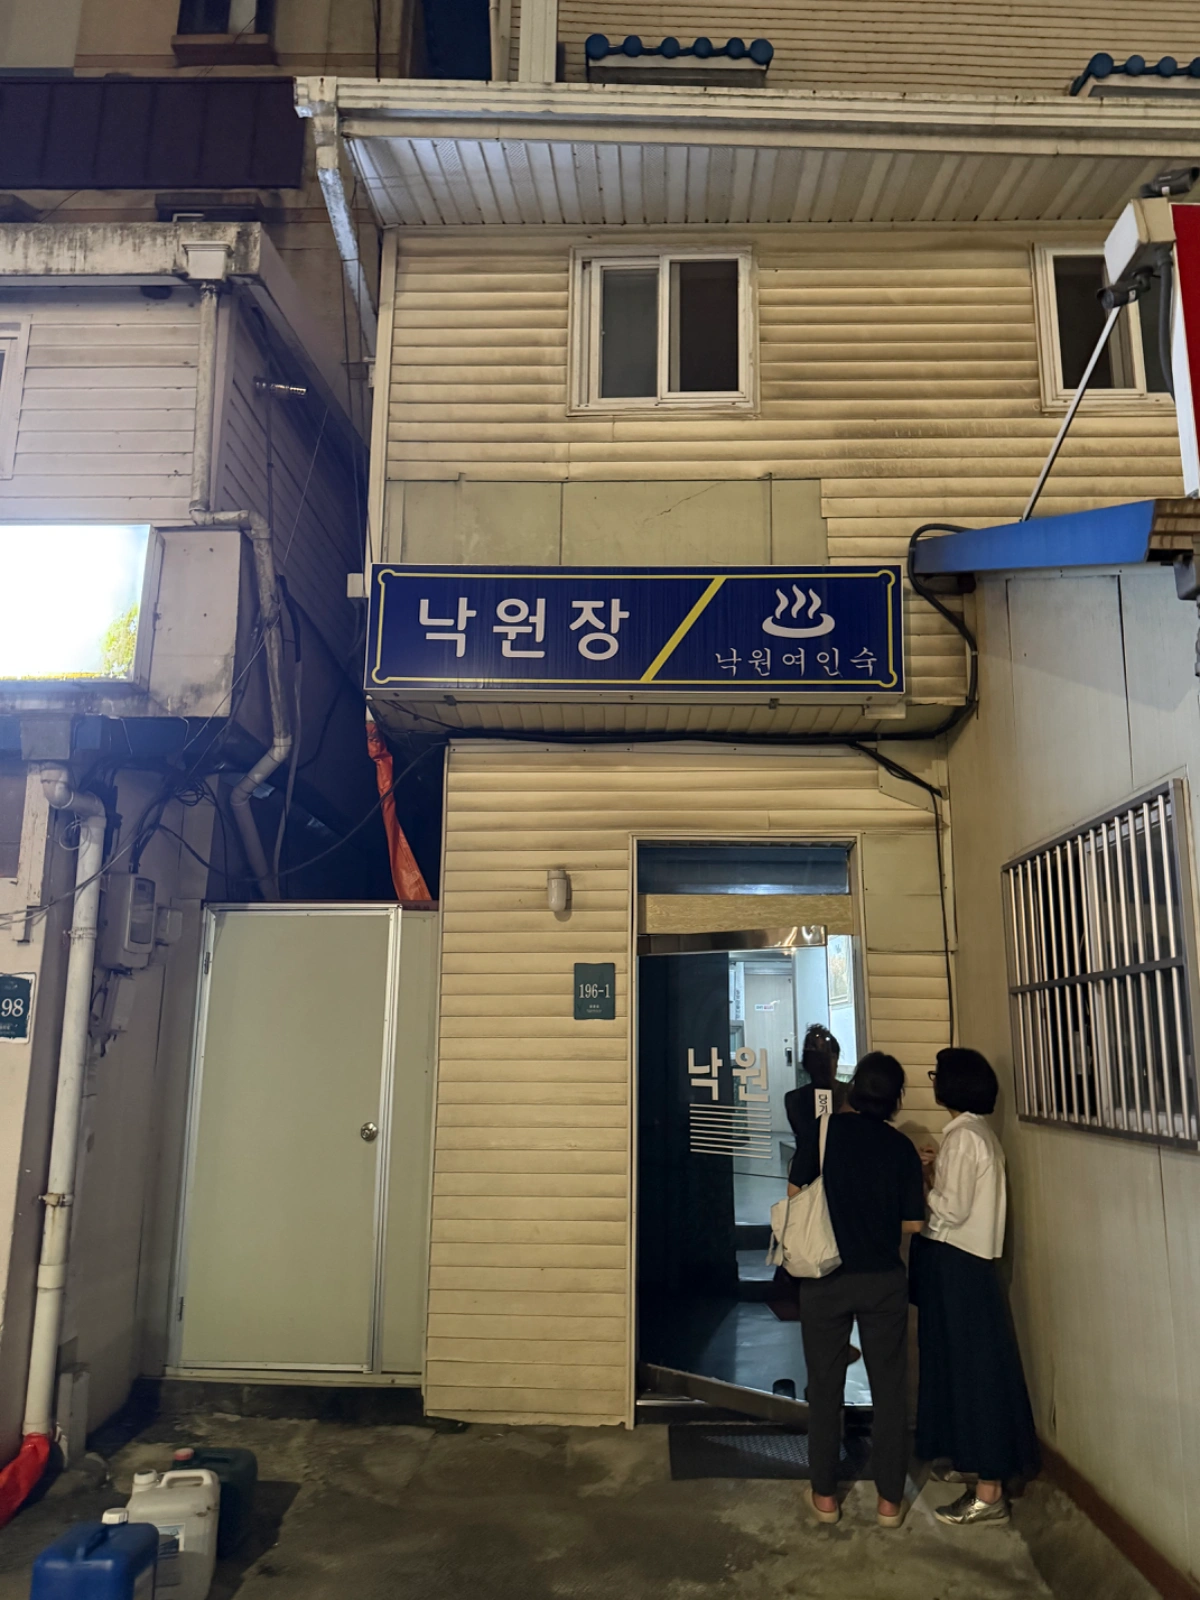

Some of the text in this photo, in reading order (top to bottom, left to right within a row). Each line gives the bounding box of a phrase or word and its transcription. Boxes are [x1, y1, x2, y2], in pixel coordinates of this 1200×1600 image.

[419, 597, 630, 661] 낙원장
[715, 647, 877, 677] 낙원여인숙
[579, 983, 610, 999] 196-1
[1, 998, 24, 1017] 98
[688, 1046, 770, 1102] 낙원
